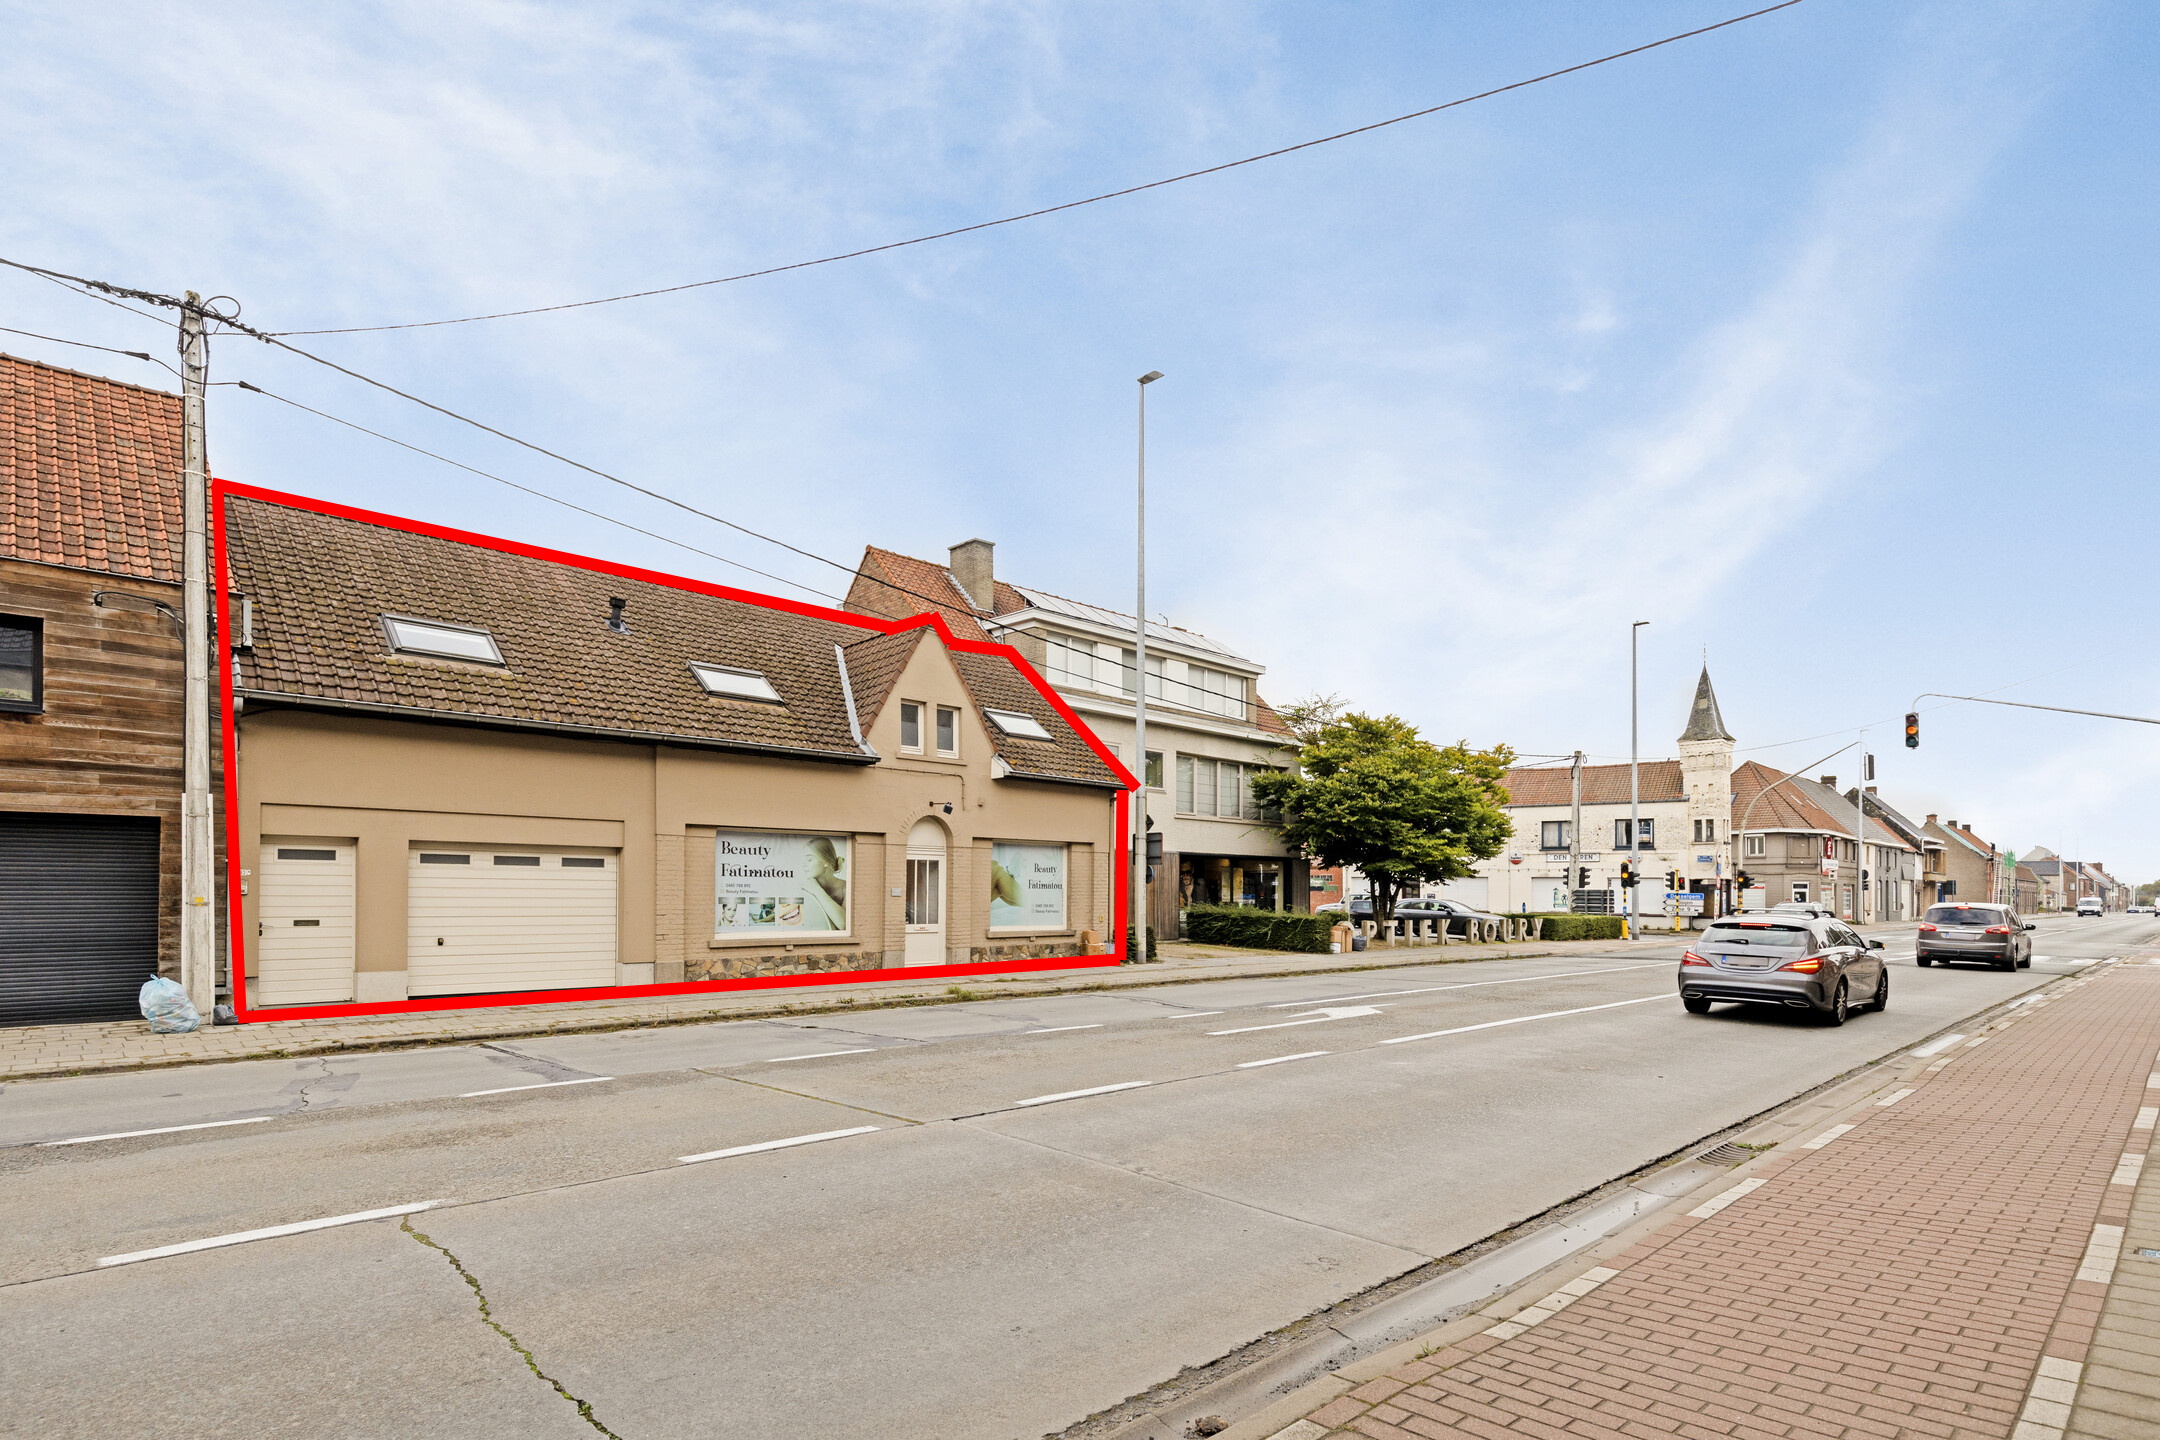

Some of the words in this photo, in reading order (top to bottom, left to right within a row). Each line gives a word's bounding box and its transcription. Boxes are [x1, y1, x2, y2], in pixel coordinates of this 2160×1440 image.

[721, 840, 771, 860] Beauty
[721, 863, 794, 878] Fatimatou
[1034, 863, 1058, 876] Beauty
[1028, 879, 1063, 890] Fatimatou
[1466, 918, 1544, 943] BOURY
